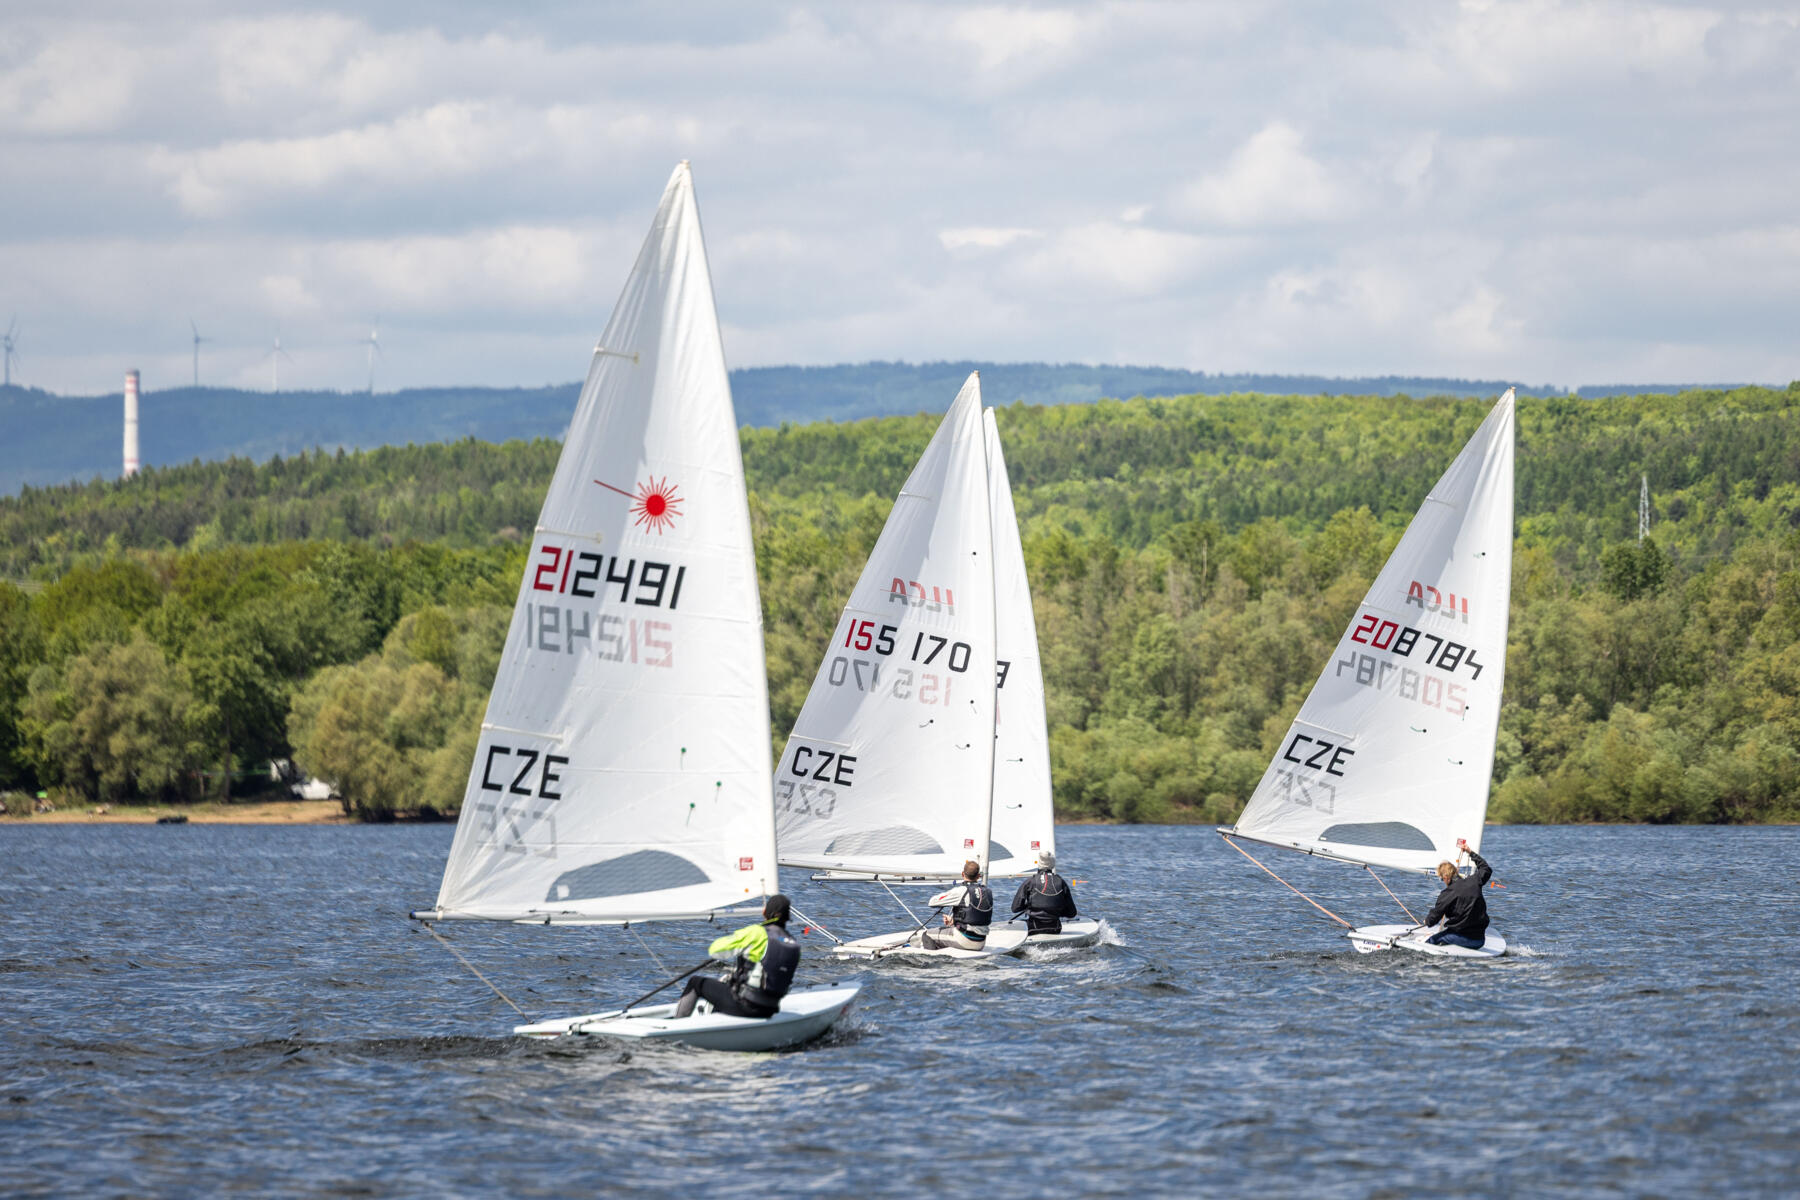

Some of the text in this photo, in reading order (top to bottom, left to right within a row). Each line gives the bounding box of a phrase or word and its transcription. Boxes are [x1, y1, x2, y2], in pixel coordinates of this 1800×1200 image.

[533, 545, 686, 609] 212491
[845, 618, 972, 673] 155 170
[1352, 614, 1484, 680] 208784
[482, 745, 569, 800] CZE
[791, 746, 857, 787] CZE
[1284, 733, 1355, 777] CZE
